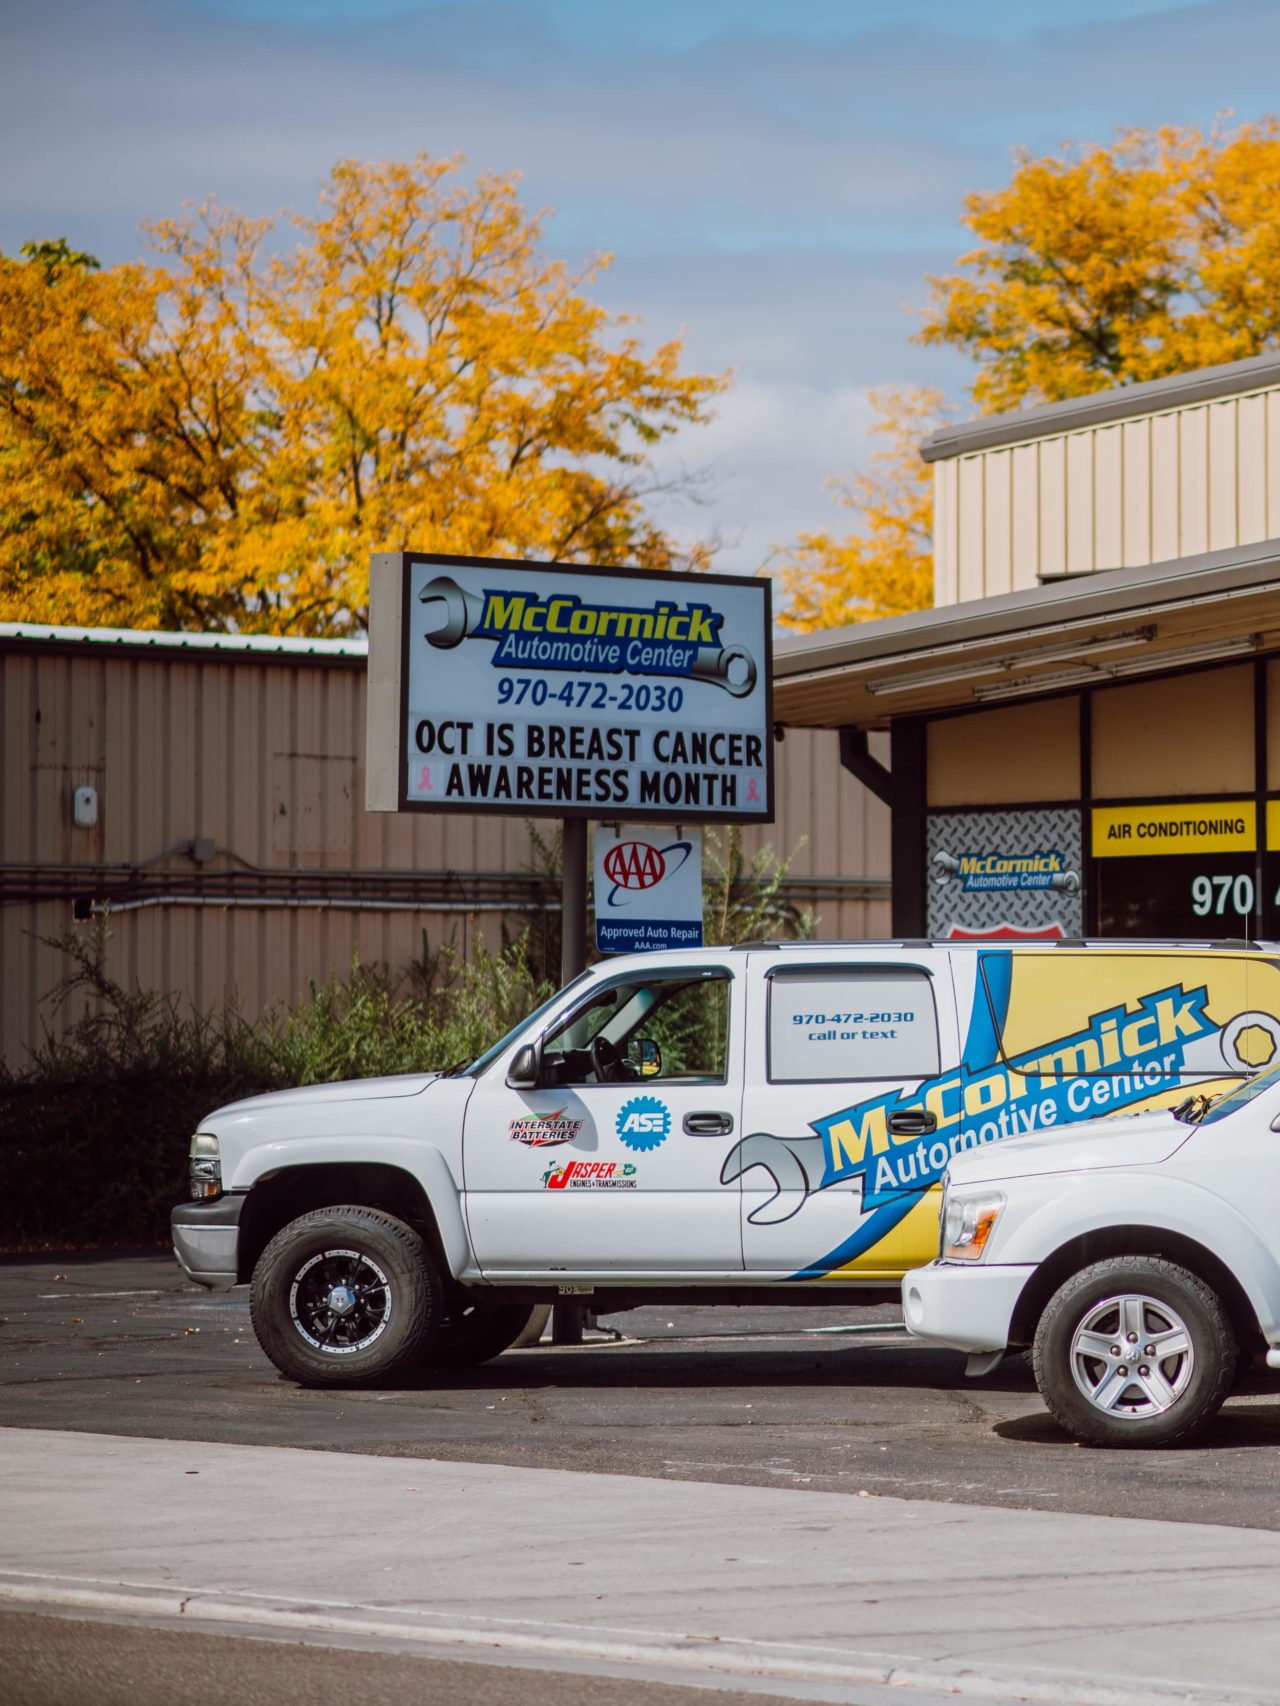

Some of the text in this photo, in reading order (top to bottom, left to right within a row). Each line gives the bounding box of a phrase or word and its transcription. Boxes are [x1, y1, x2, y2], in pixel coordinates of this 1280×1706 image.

[484, 595, 715, 643] McCormick
[501, 633, 695, 668] Automotive Center
[497, 677, 684, 713] 970-472-2030
[415, 720, 763, 767] OCT IS BREAST CANCER
[446, 764, 737, 806] AWARENESS MONTH
[1107, 818, 1245, 839] AIR CONDITIONING
[608, 843, 662, 889] AAA
[960, 854, 1061, 874] McCormick
[966, 873, 1052, 888] Automotive Center
[1192, 874, 1254, 915] 970
[600, 926, 700, 941] Approved Auto Repair
[634, 941, 667, 950] AAA.com
[792, 1012, 914, 1025] 970-472-2030
[808, 1029, 897, 1041] call or text
[511, 1120, 581, 1130] INTERSTATE
[621, 1113, 664, 1132] ASE
[874, 1052, 1176, 1195] Automotive Center
[512, 1131, 575, 1140] BATTERIES
[548, 1161, 617, 1188] JASPER
[569, 1179, 591, 1188] ENGINES
[595, 1180, 637, 1188] TRANSMISSIONS
